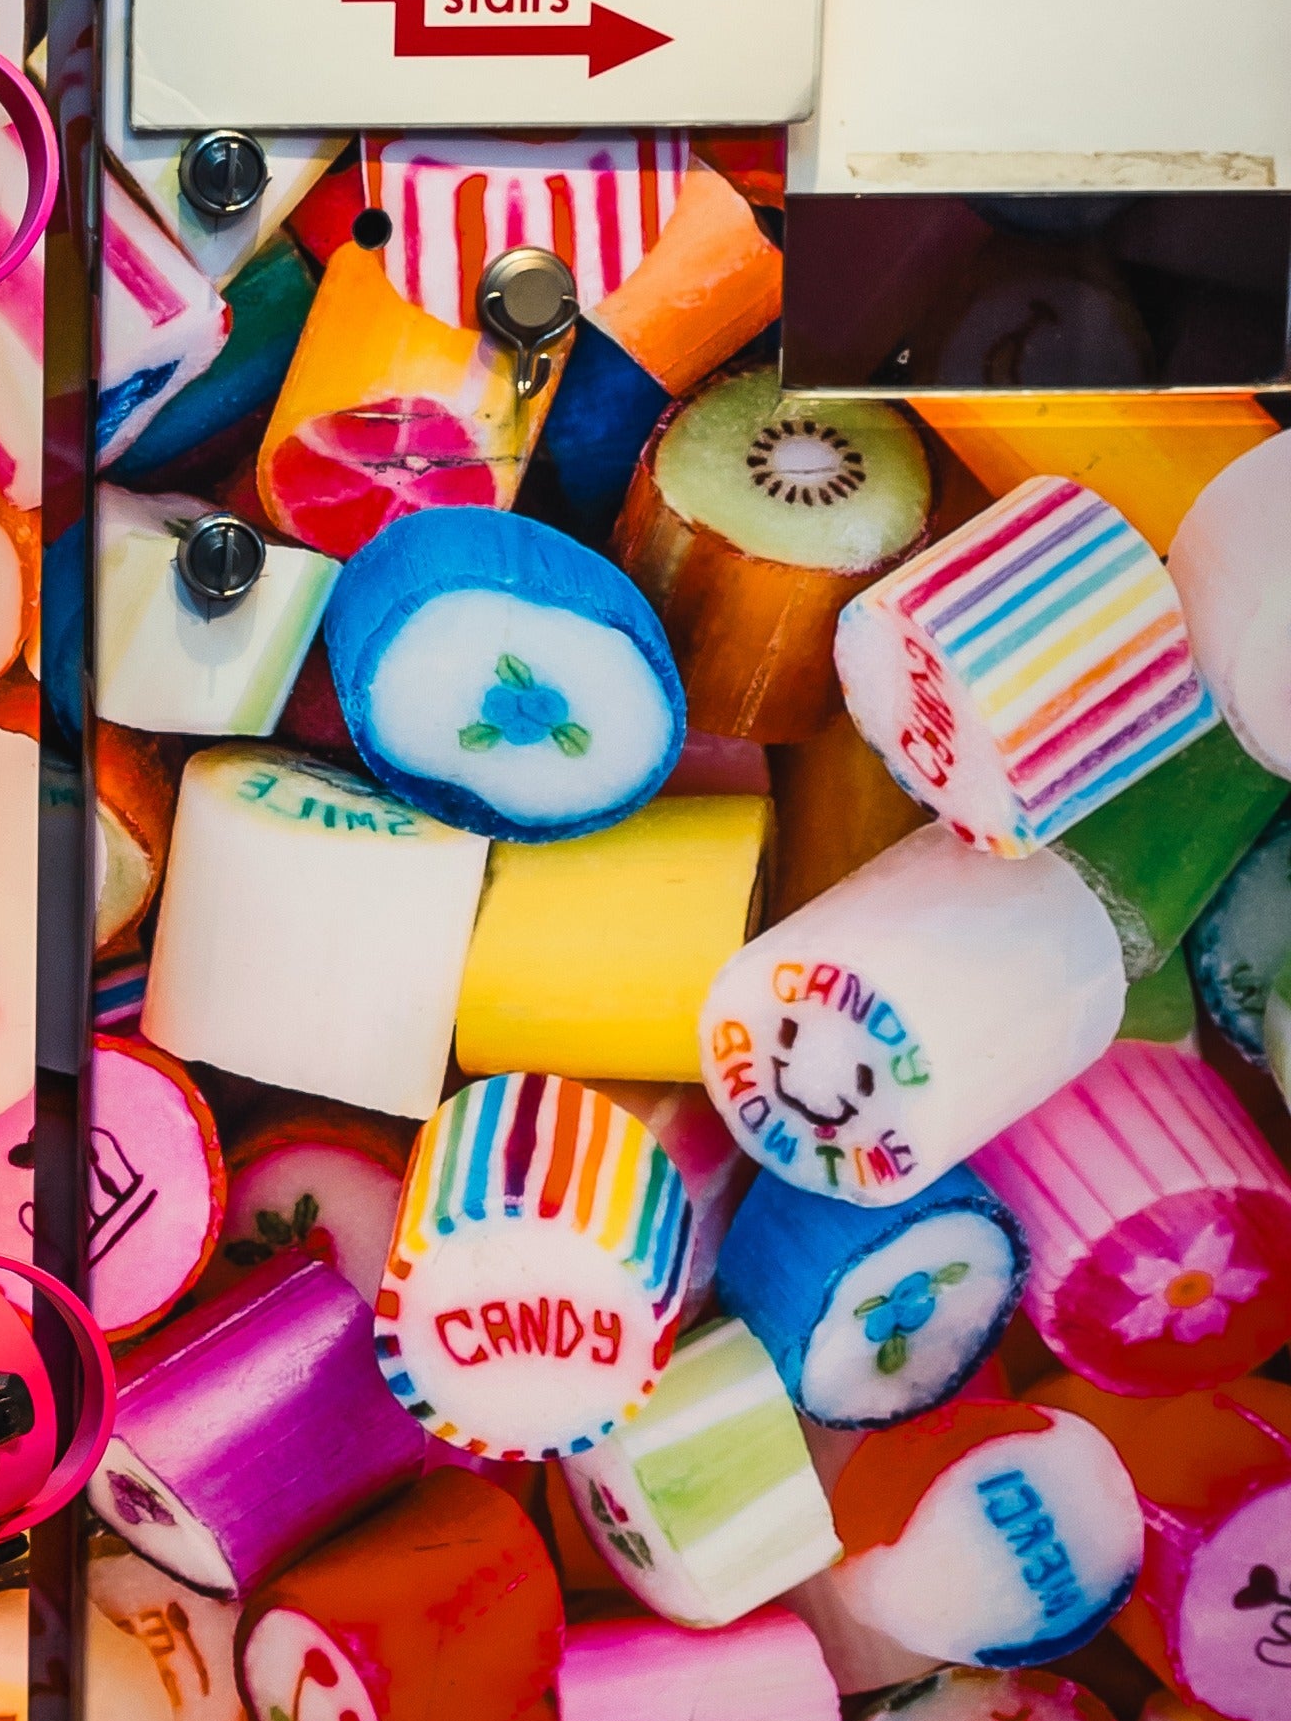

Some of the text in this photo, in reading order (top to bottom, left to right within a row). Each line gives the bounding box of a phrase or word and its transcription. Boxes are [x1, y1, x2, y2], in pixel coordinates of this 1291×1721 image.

[772, 961, 932, 1090] CANDY
[713, 1019, 920, 1188] SHOW TIME
[434, 1295, 625, 1368] CANDY
